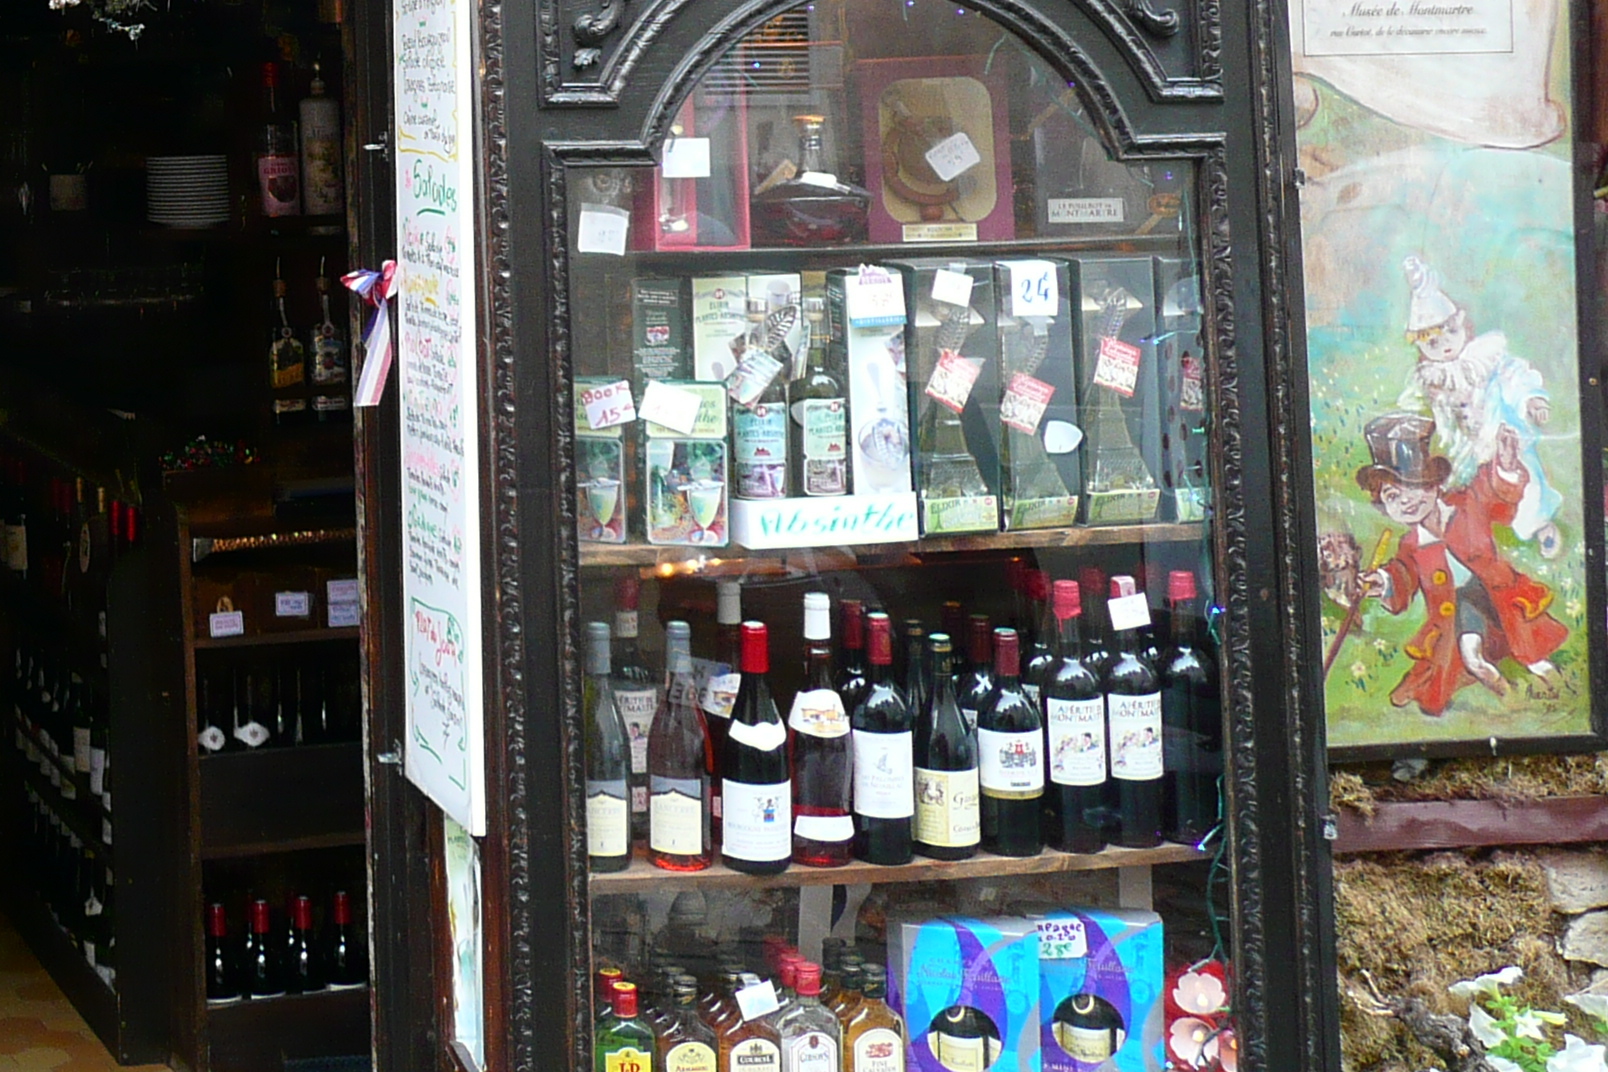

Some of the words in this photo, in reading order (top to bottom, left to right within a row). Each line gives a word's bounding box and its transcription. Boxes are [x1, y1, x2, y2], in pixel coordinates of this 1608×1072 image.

[1342, 1, 1383, 18] Musée
[1385, 1, 1402, 18] de
[1401, 1, 1474, 18] Montmartre
[413, 159, 457, 212] Salades
[760, 502, 915, 538] Absinthe
